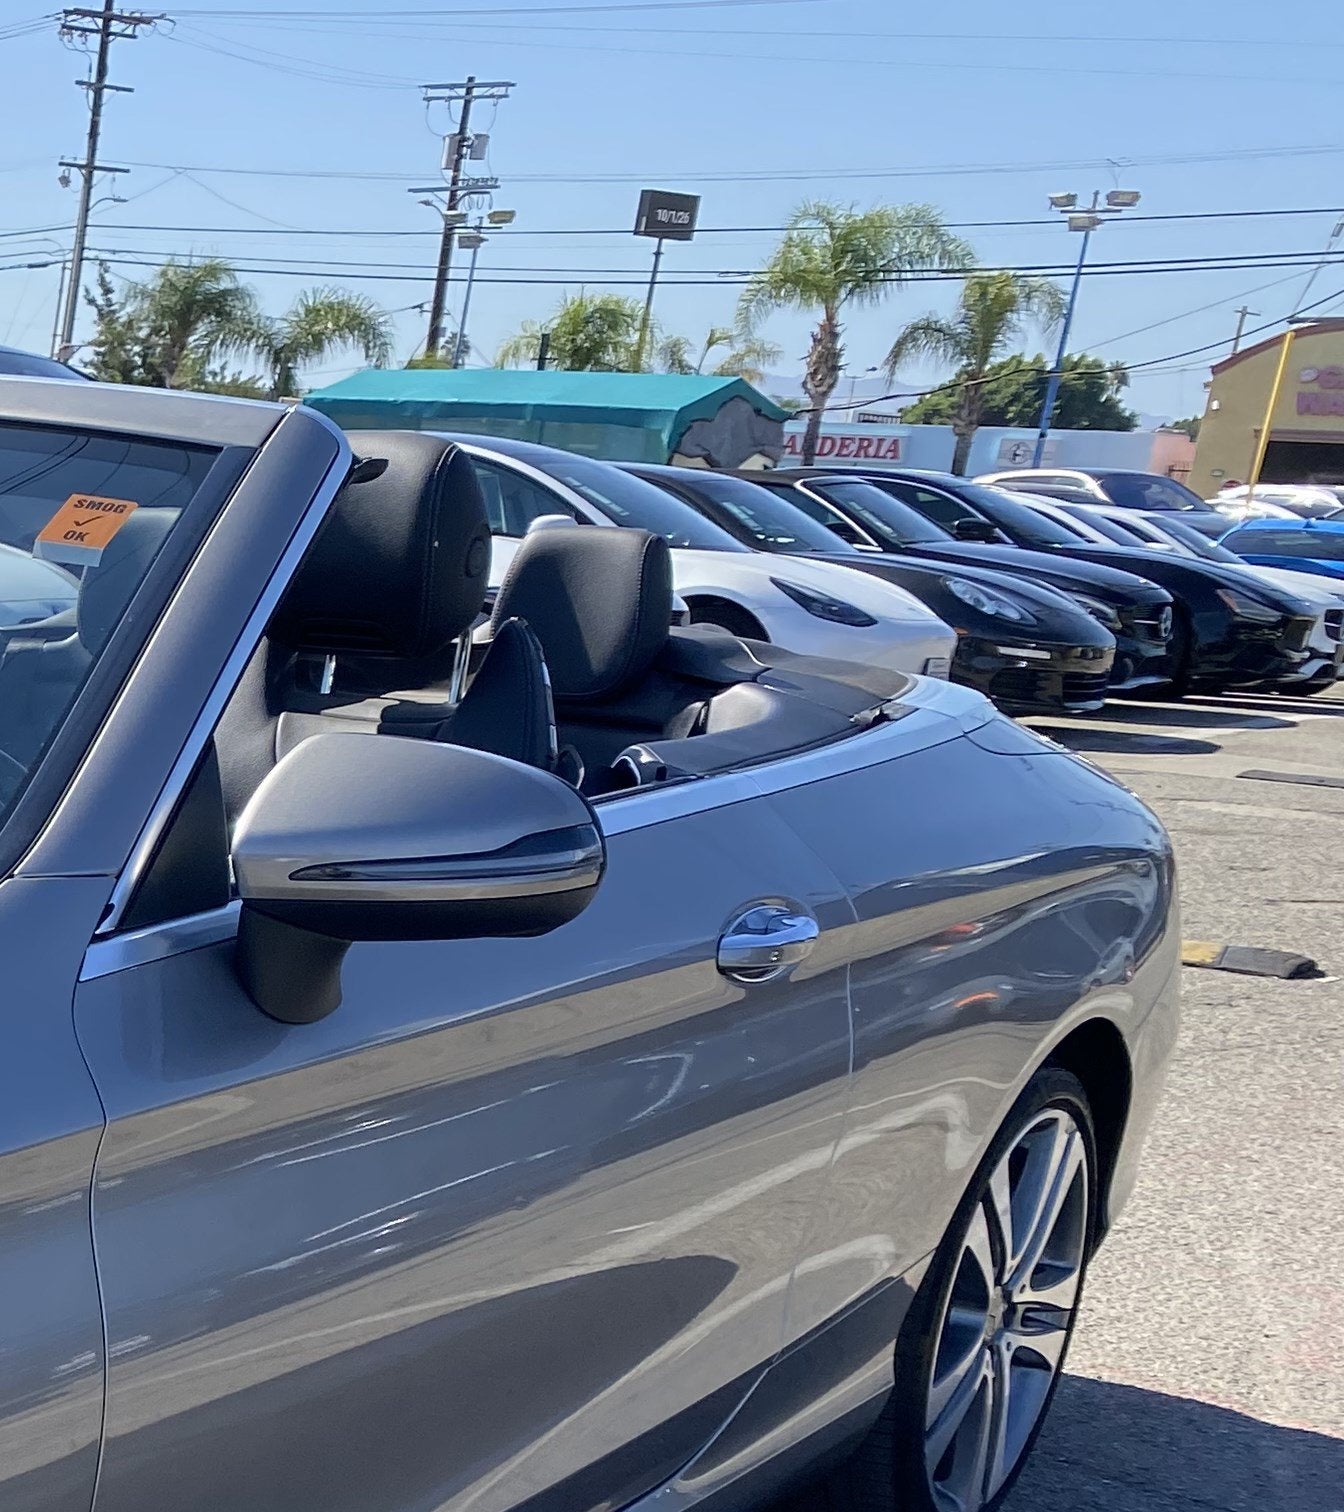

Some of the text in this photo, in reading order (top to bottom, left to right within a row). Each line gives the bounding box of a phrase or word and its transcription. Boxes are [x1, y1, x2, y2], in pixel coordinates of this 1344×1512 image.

[782, 434, 900, 460] ADERIA
[74, 499, 127, 514] SMOG
[63, 530, 89, 542] OK
